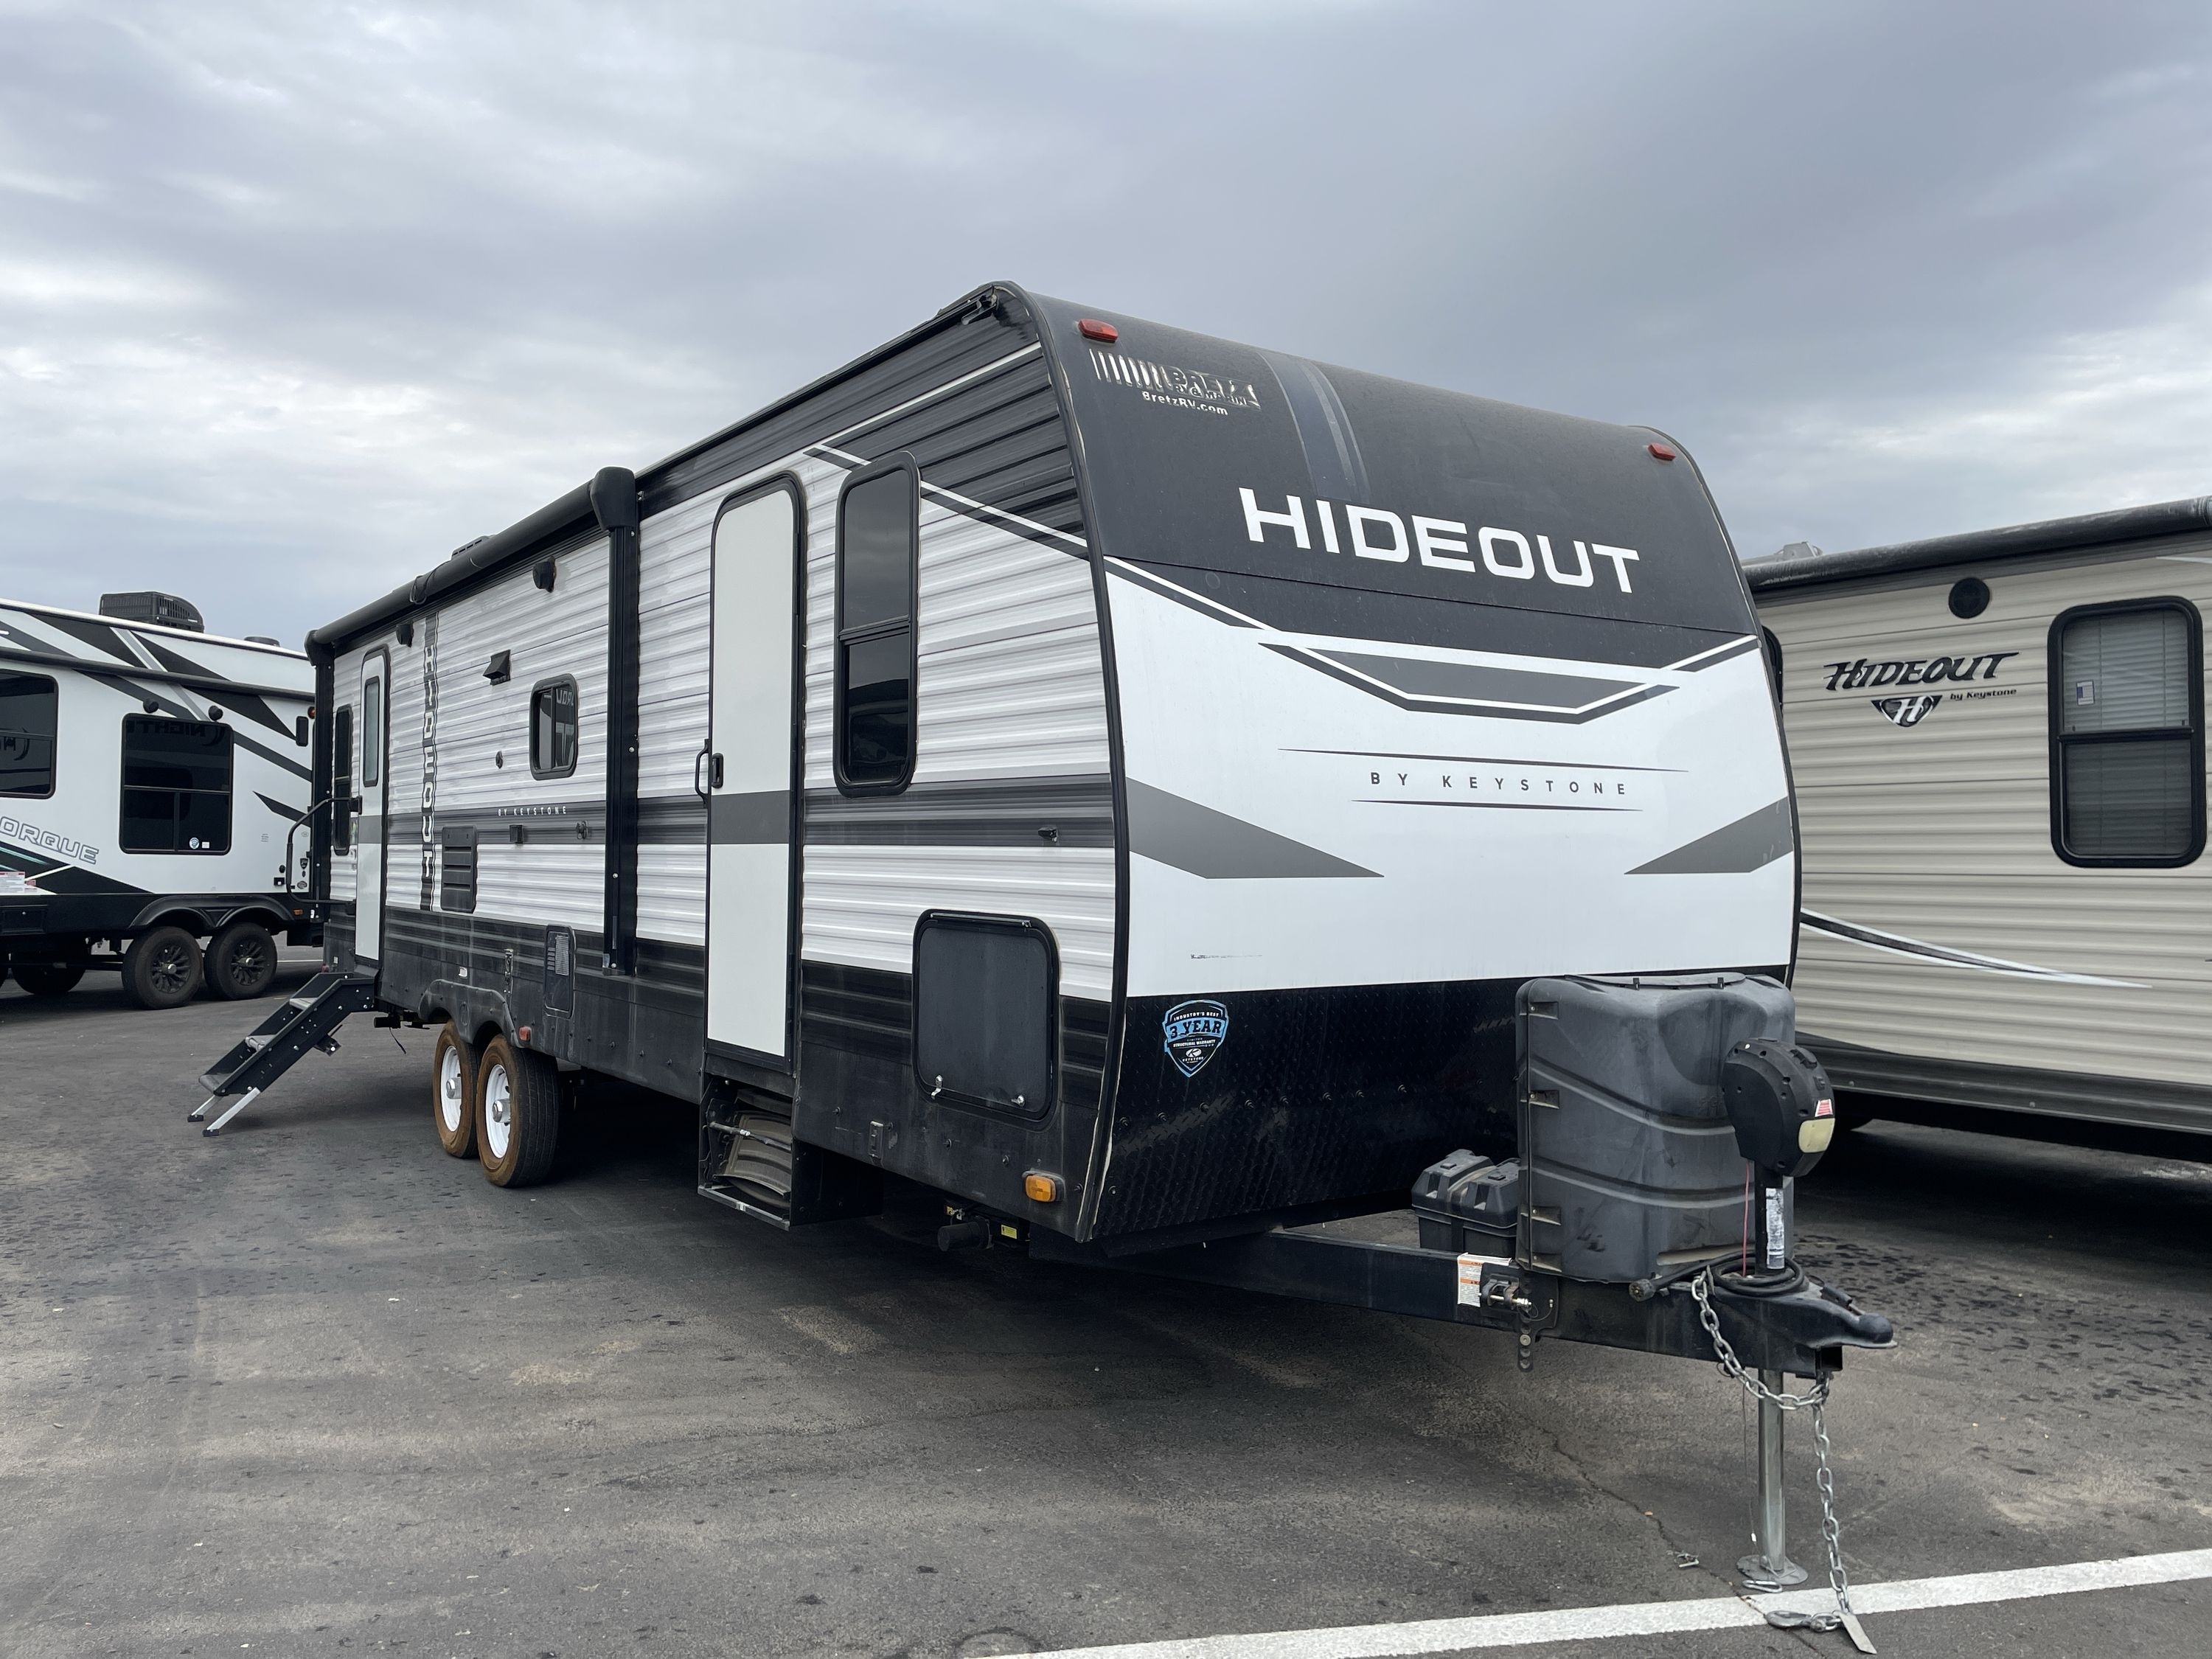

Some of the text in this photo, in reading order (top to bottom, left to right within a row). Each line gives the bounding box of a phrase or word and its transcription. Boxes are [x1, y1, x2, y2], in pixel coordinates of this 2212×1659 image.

[1142, 390, 1228, 416] BretzRV.com
[1239, 487, 1640, 594] HIDEOUT
[1823, 652, 2020, 691] HIDEOUT
[1950, 687, 2017, 700] by Keystone
[422, 644, 434, 877] HIDEOUT
[1370, 771, 1625, 795] BY KEYSTONE
[498, 805, 566, 817] BY KEYSTONE
[1169, 1020, 1222, 1040] 3 YEAR
